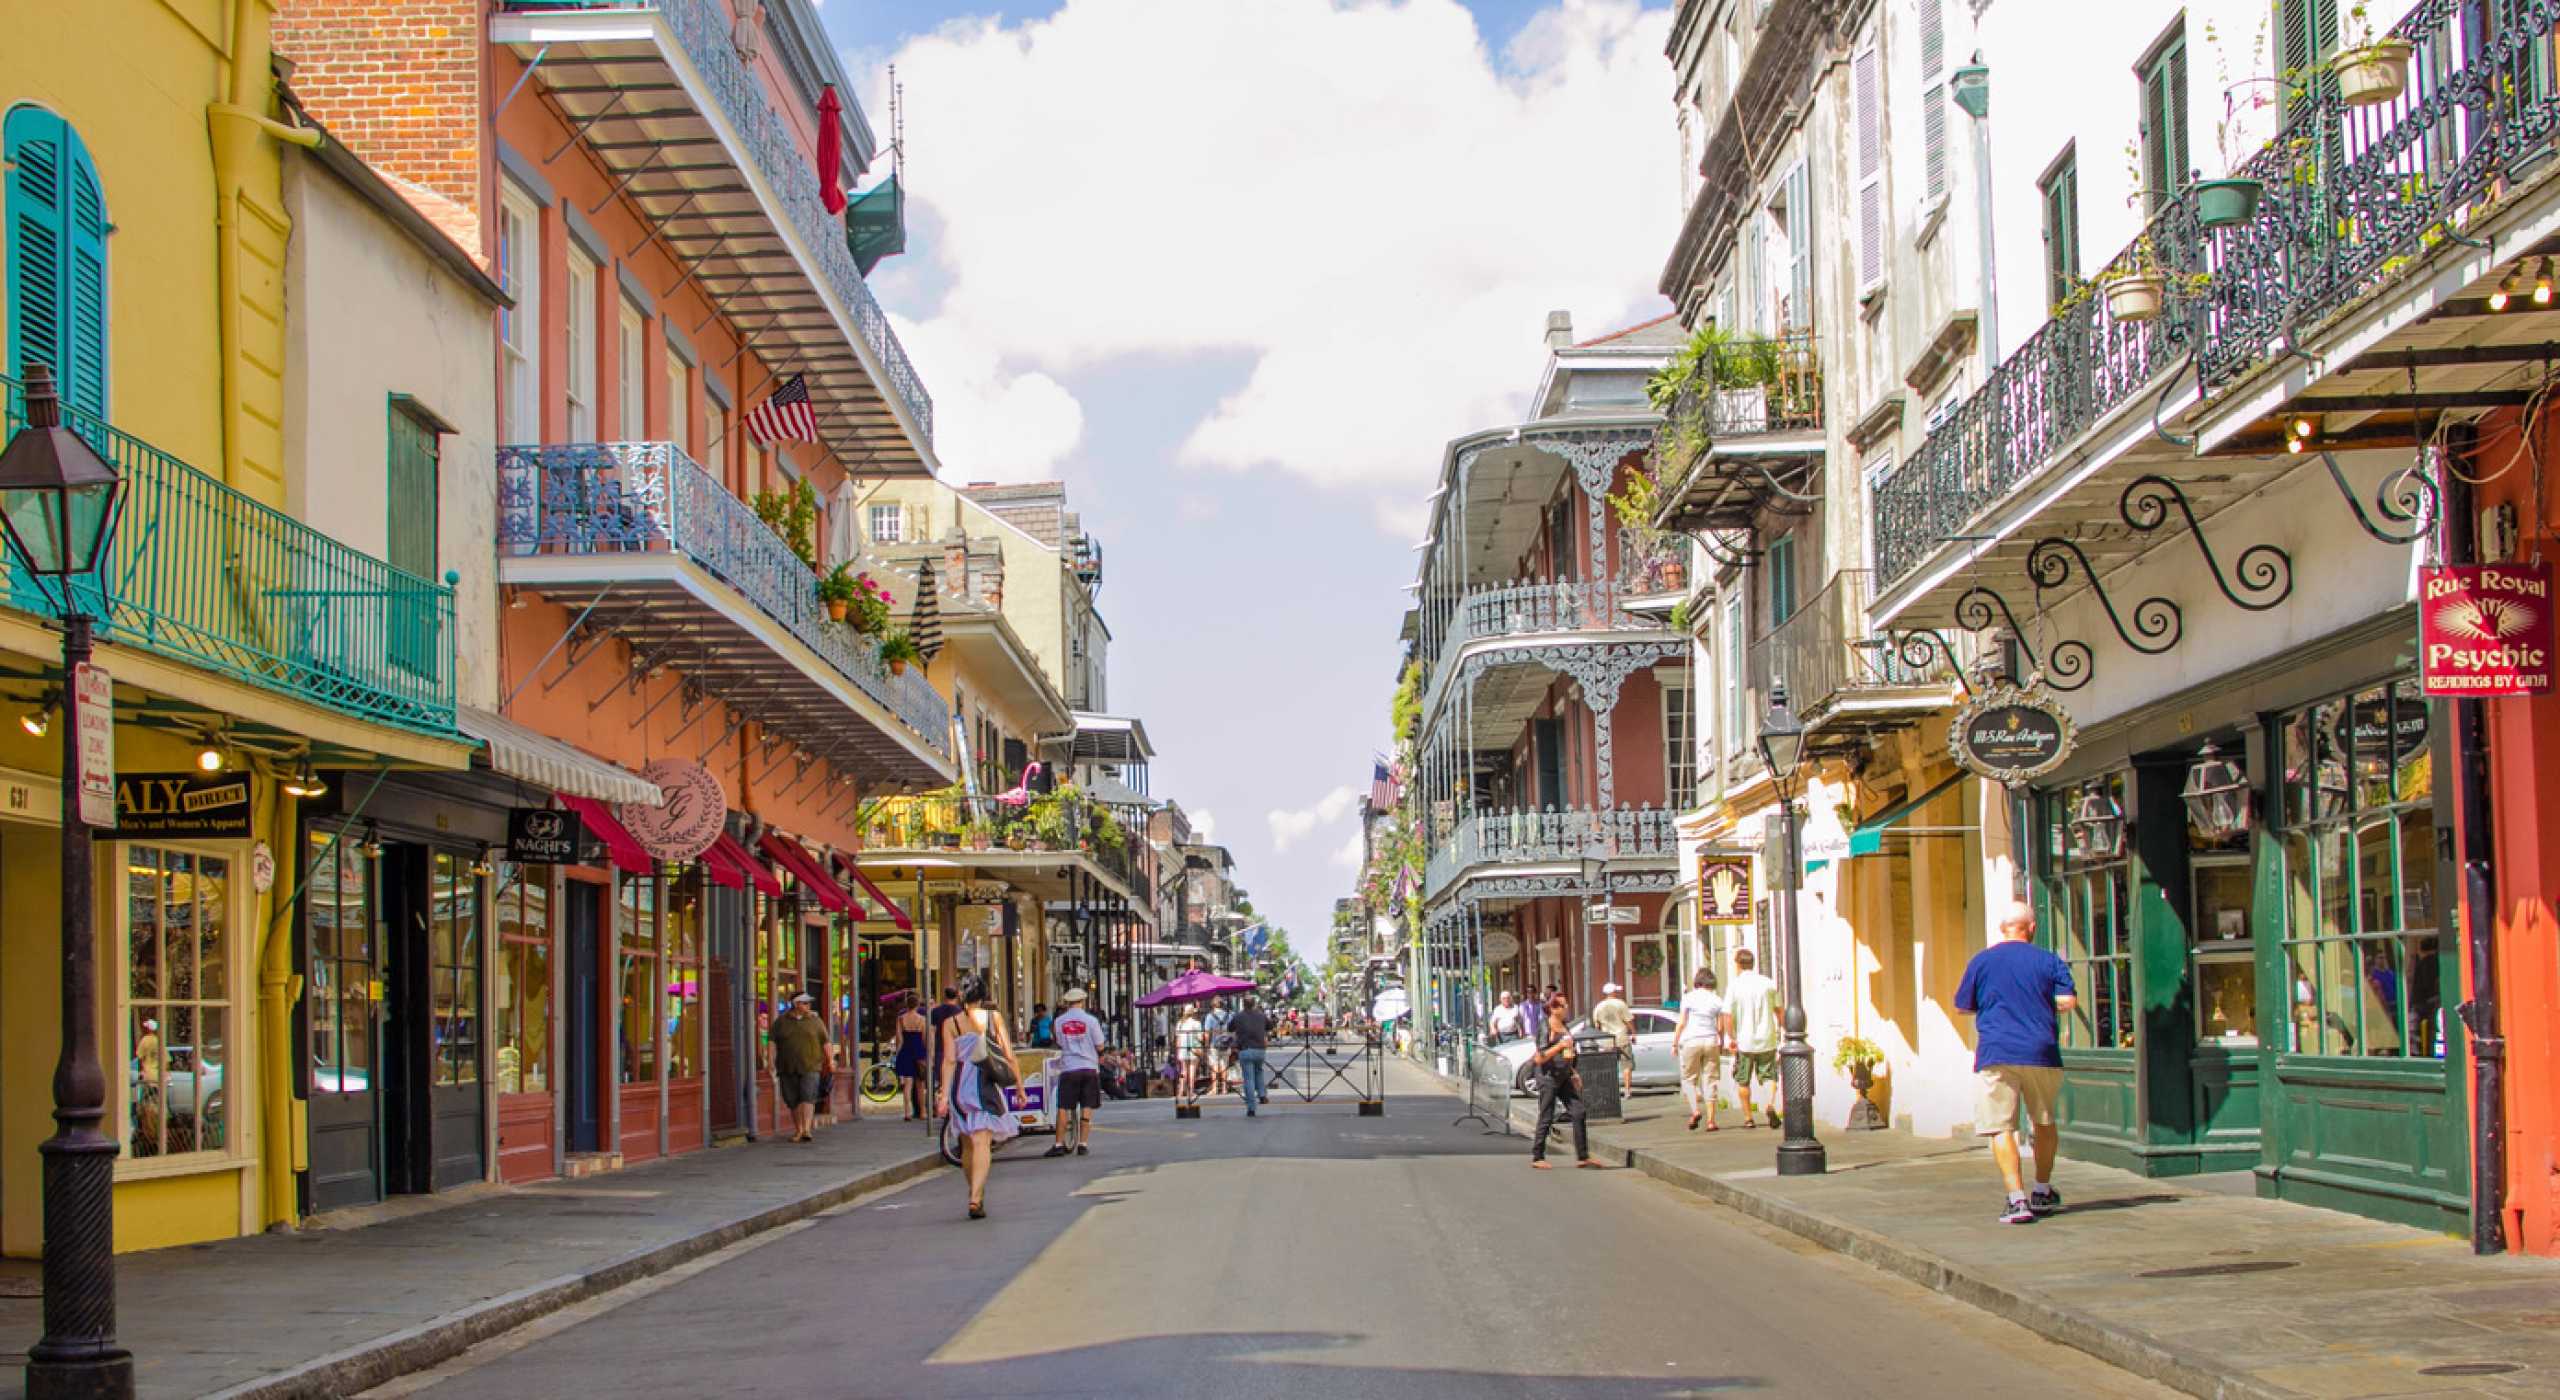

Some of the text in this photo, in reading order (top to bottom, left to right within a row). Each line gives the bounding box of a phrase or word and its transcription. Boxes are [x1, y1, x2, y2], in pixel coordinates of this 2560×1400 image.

[2427, 570, 2546, 600] Rue Royal
[2429, 642, 2545, 672] Psychic
[2427, 673, 2548, 689] READINGS BY GINA
[82, 711, 109, 734] LOADING
[88, 735, 105, 755] ZONE
[188, 785, 245, 808] DIRECT
[149, 818, 165, 829] and
[210, 817, 246, 830] Apparel
[514, 838, 571, 855] NAGHI'S
